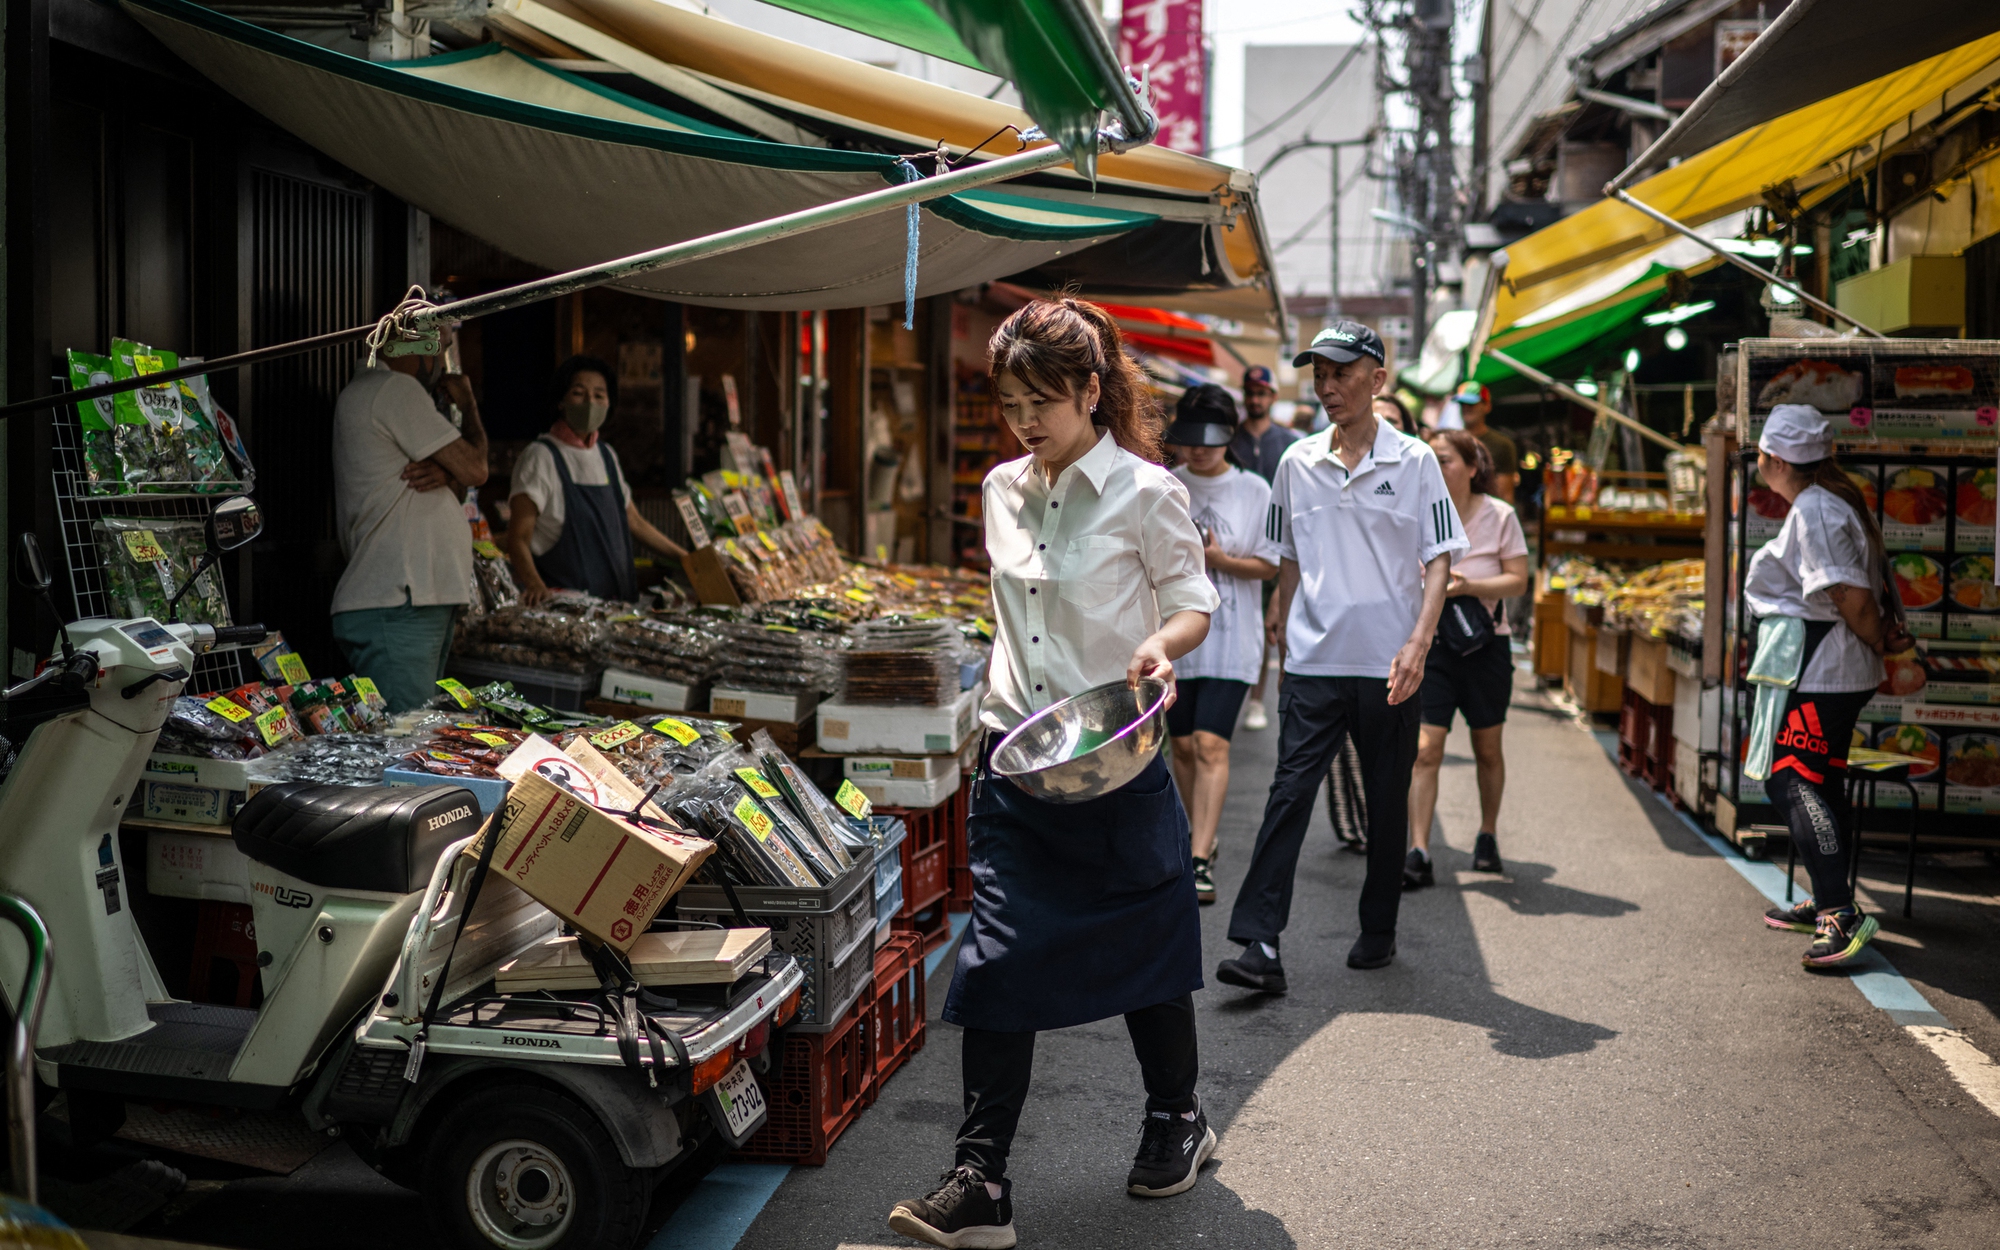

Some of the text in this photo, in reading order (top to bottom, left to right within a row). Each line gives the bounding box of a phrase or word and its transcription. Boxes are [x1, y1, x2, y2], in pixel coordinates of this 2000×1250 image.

[269, 718, 287, 736] 500
[599, 727, 631, 745] 800
[1775, 724, 1829, 755] didas
[428, 805, 473, 831] HONDA
[275, 886, 313, 908] UP
[502, 1035, 562, 1049] HONDA
[724, 1070, 744, 1092] 中央区
